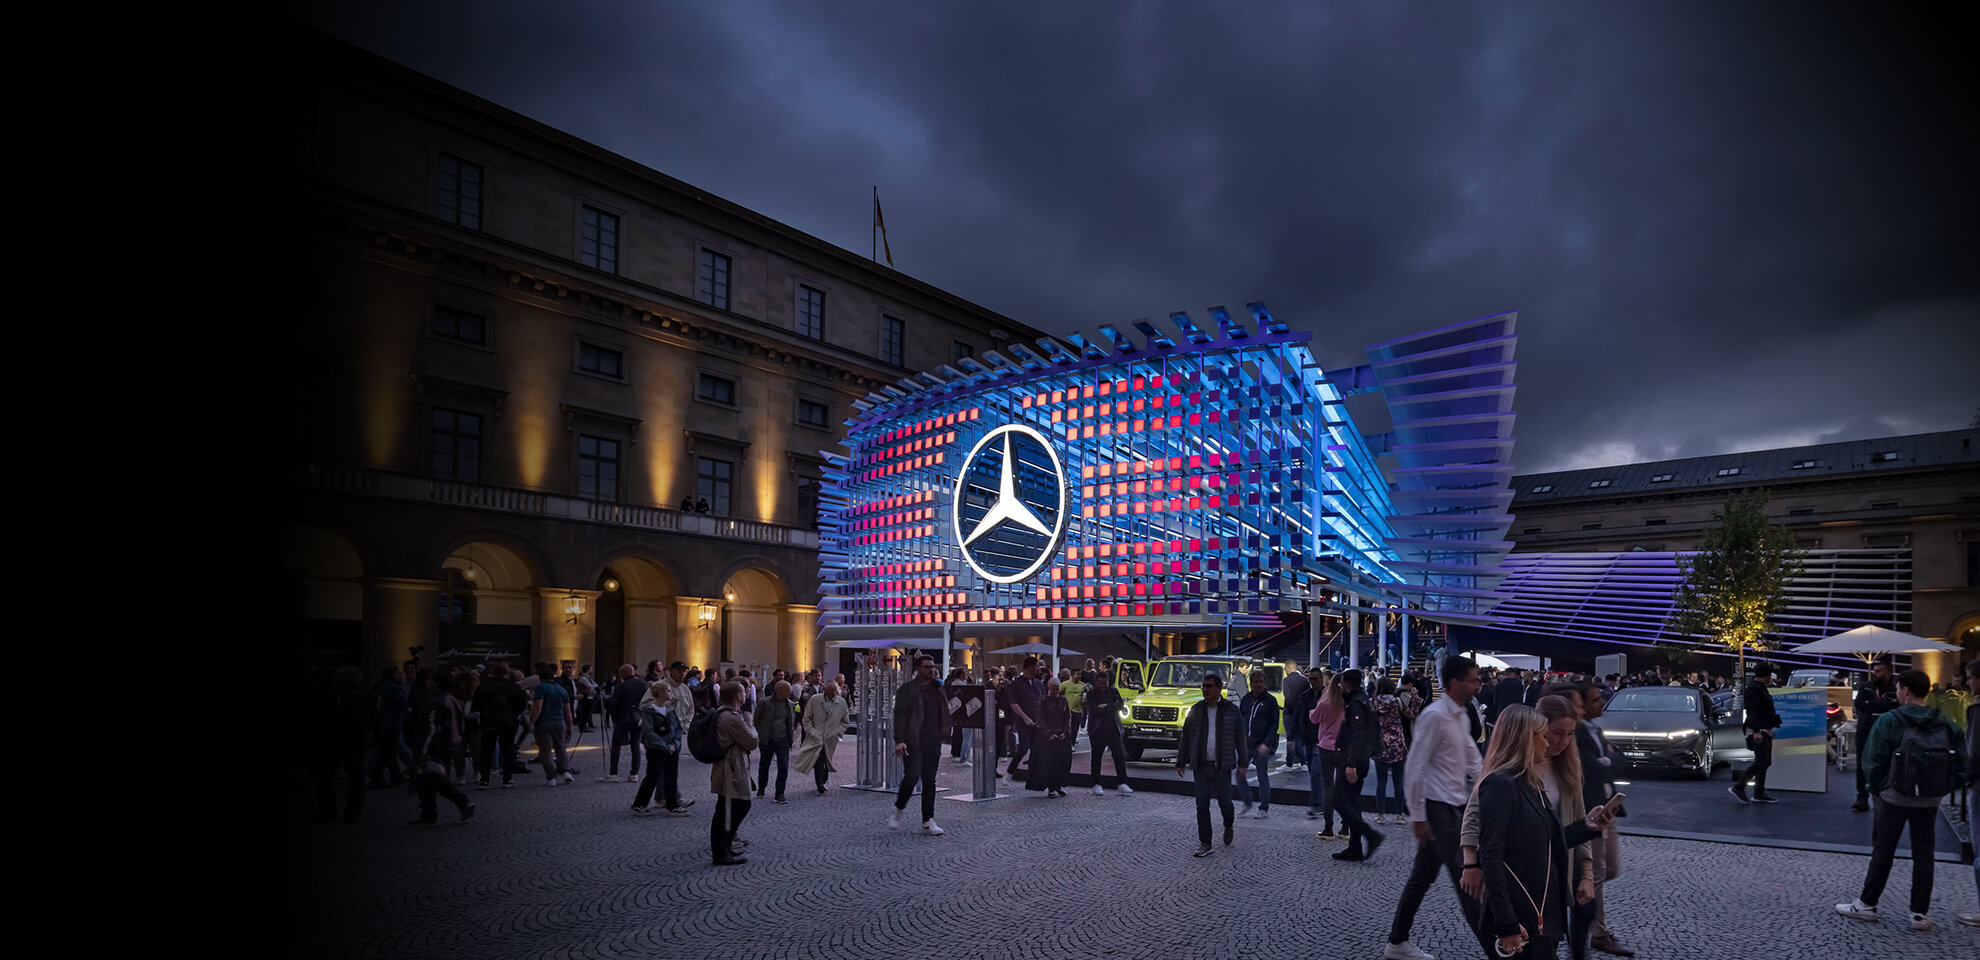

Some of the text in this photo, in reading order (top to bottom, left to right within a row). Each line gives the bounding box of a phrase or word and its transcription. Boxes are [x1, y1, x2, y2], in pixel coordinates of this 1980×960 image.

[853, 697, 861, 714] Test
[867, 689, 877, 716] Family
[881, 670, 889, 719] Information
